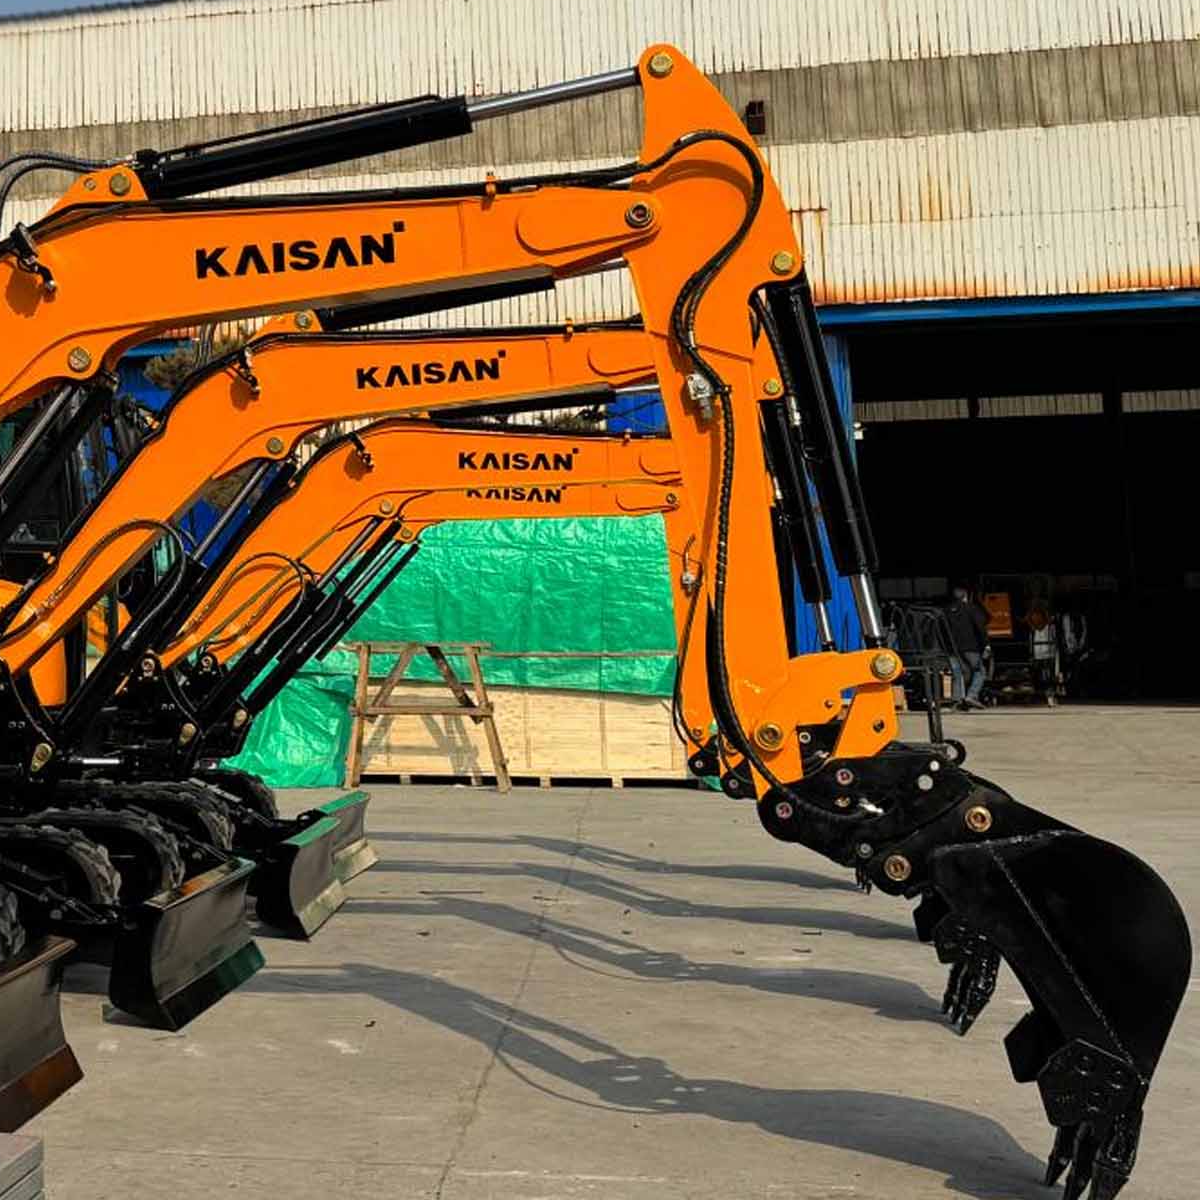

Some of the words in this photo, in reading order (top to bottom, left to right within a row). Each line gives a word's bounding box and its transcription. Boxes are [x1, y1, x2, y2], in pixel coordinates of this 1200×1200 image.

[195, 231, 396, 279] KAISAN
[355, 358, 500, 389] KAISAN
[458, 451, 573, 471] KAISAN
